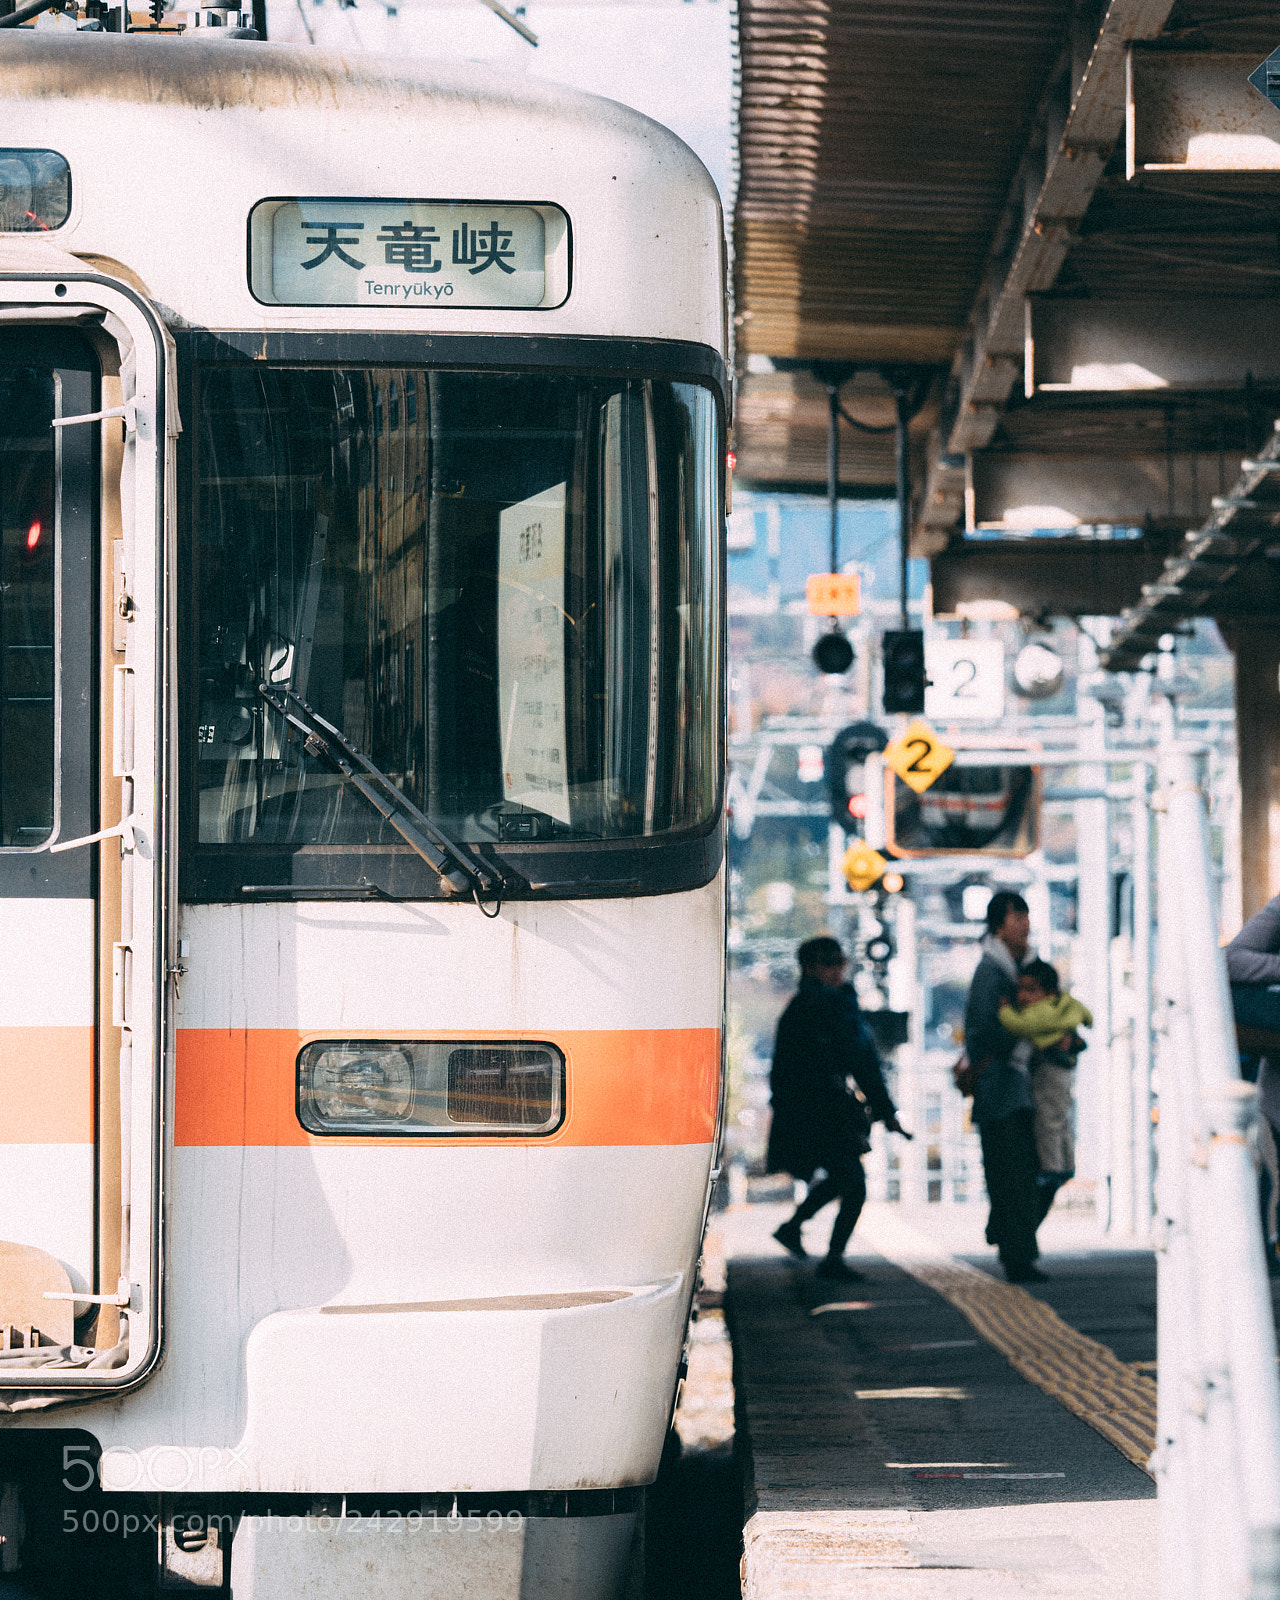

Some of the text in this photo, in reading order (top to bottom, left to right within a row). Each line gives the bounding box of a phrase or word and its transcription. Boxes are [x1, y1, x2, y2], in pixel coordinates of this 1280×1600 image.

[300, 221, 516, 275] 天竜峡
[364, 281, 454, 300] Tenryūkyō
[952, 659, 977, 698] 2
[906, 739, 932, 772] 2
